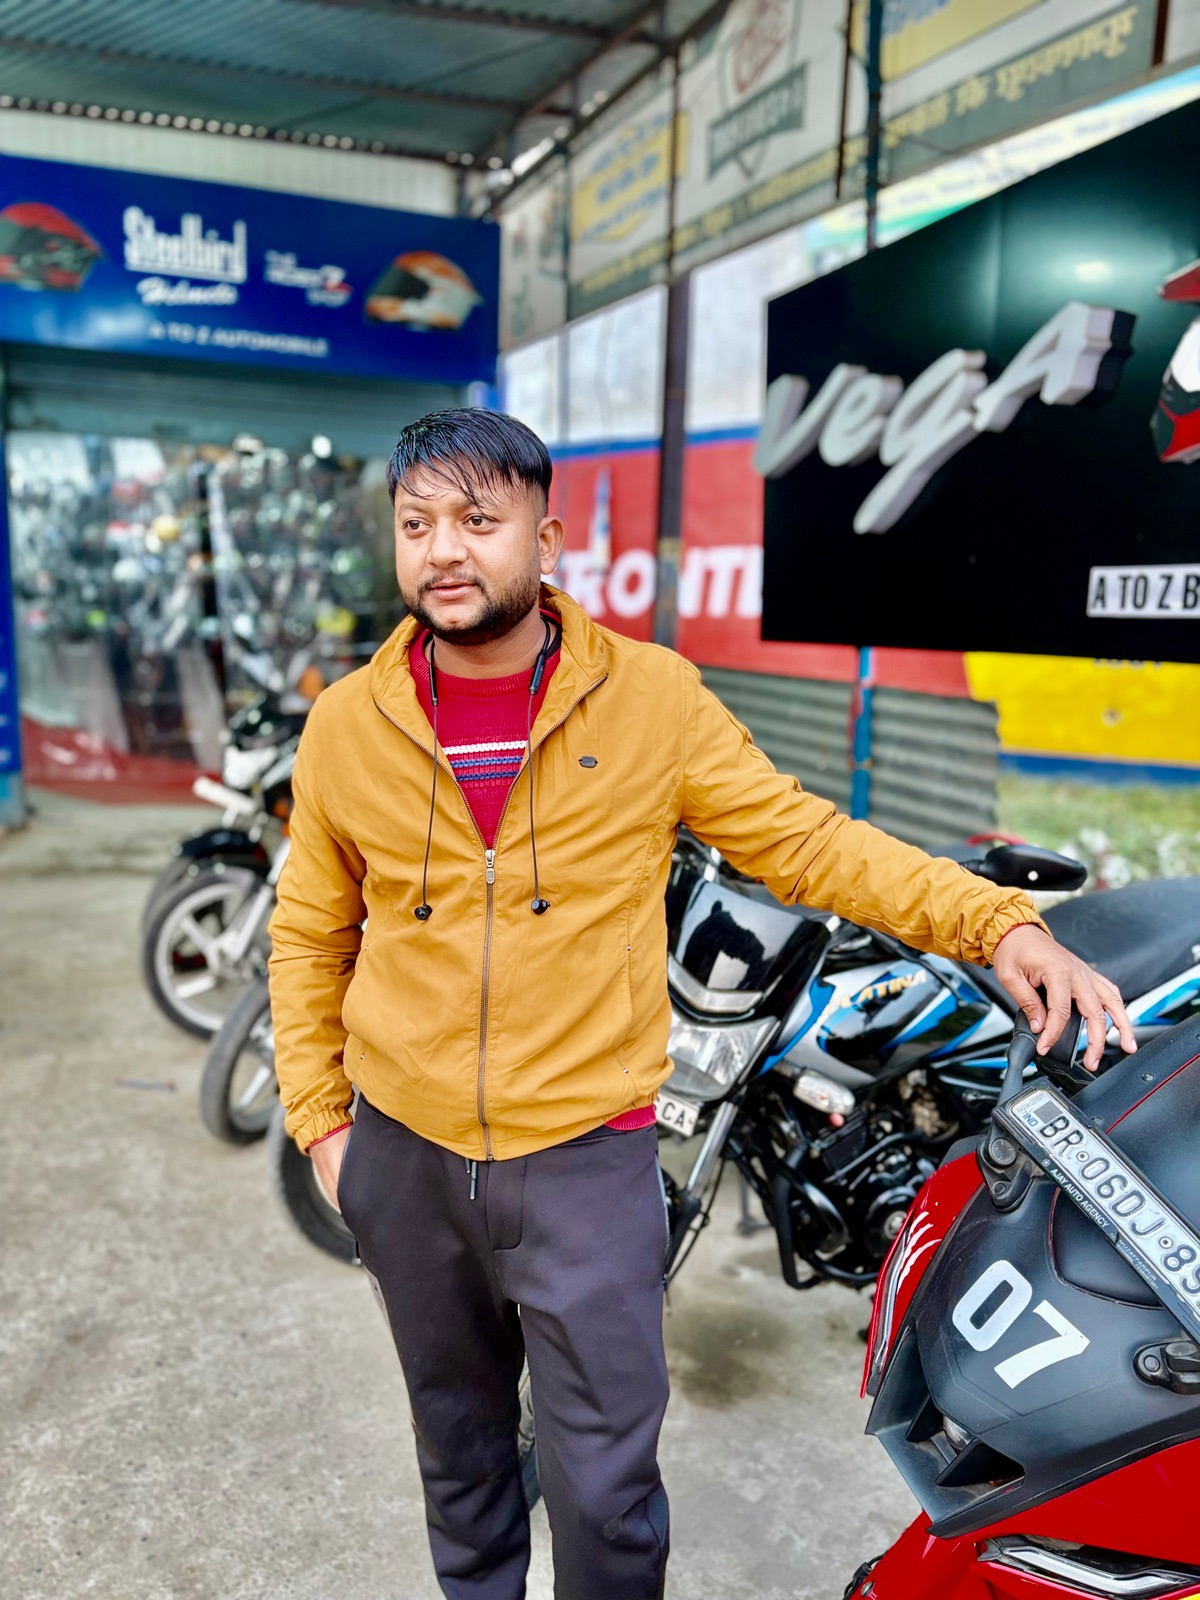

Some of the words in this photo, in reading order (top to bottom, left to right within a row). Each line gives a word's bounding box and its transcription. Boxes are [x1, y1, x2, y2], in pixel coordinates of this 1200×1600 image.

[123, 205, 247, 284] Steelbird
[210, 327, 330, 359] AUTOMOBILE
[1093, 575, 1106, 609] A
[1118, 574, 1149, 610] TO
[1158, 574, 1174, 610] Z
[1022, 1112, 1039, 1128] IND
[1049, 1168, 1069, 1185] AJAY
[1064, 1183, 1084, 1202] AUTO
[1080, 1200, 1110, 1229] AGENCY
[952, 1260, 1091, 1390] 07
